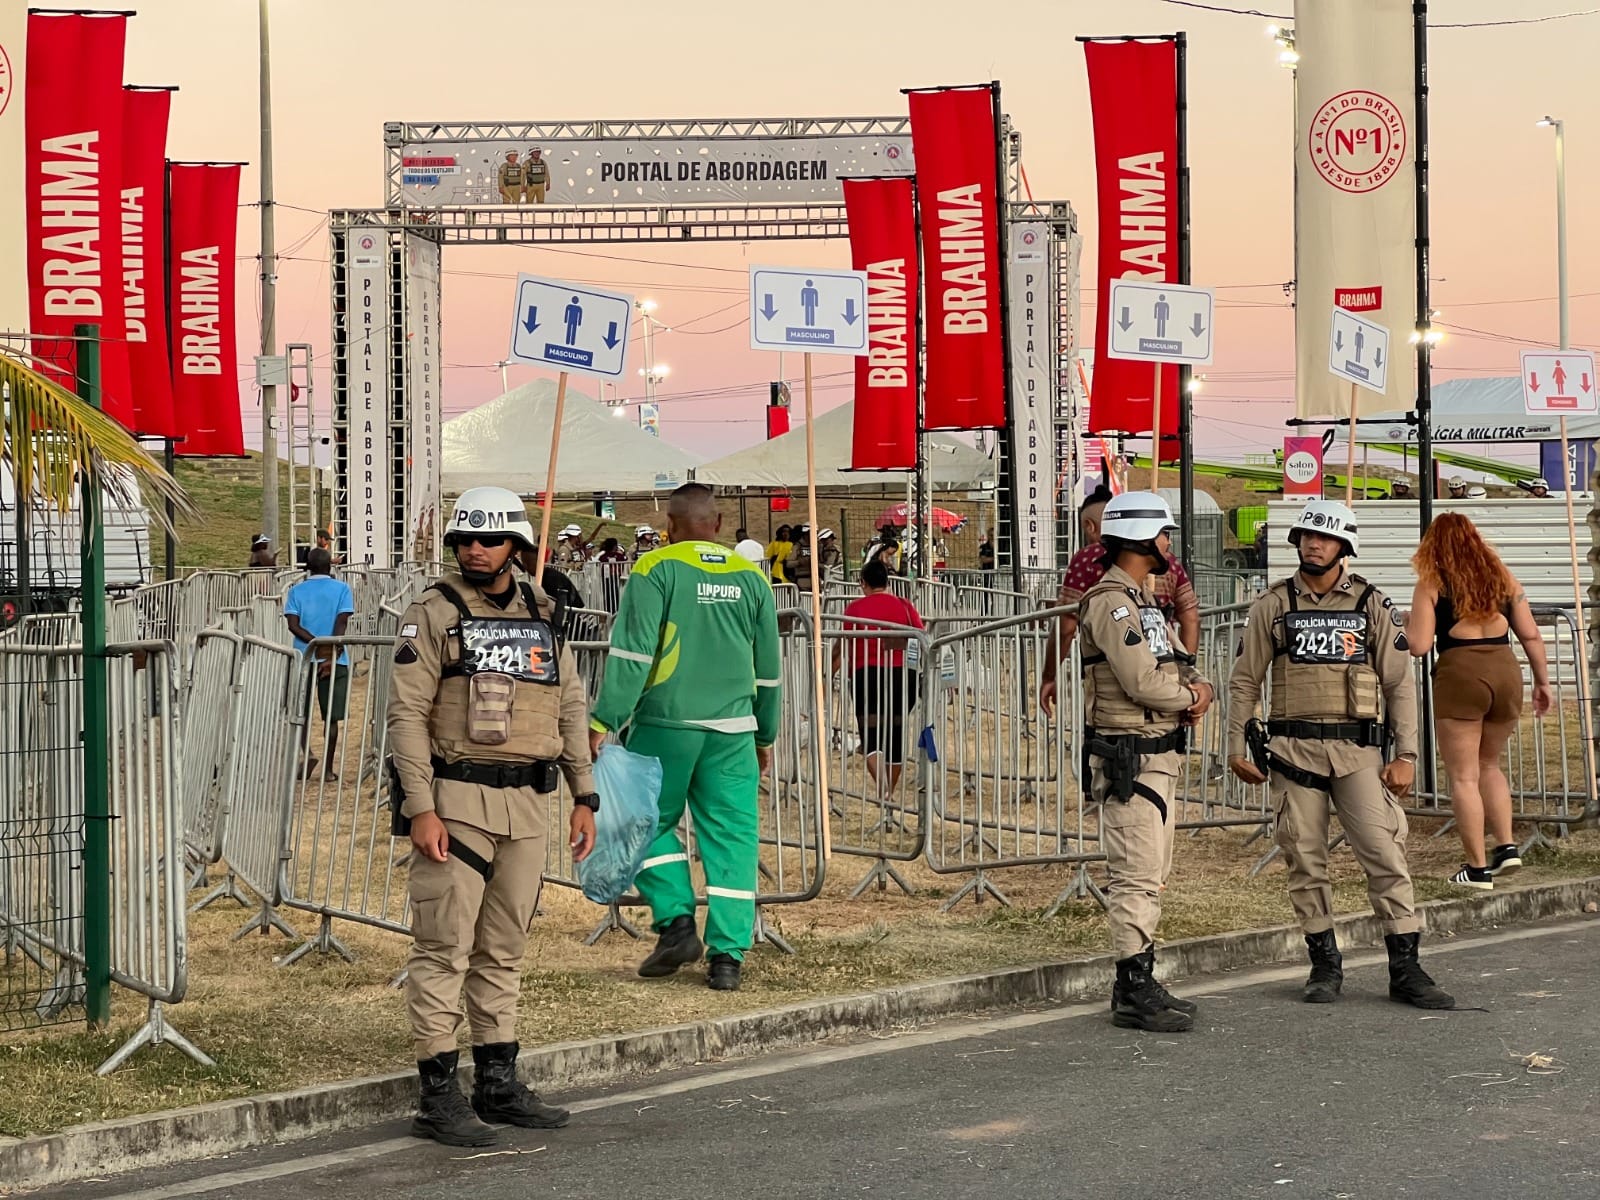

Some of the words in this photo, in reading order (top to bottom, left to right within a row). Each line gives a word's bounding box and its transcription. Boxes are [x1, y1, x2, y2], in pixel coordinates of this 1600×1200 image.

[1340, 97, 1359, 108] DO
[1365, 98, 1400, 136] BRASIL
[601, 161, 672, 182] PORTAL
[677, 161, 700, 181] DE
[705, 160, 827, 181] ABORDAGEM
[1321, 160, 1361, 188] DESDE
[1367, 157, 1396, 184] 1888
[41, 130, 103, 317] BRAHMA
[1119, 151, 1167, 282] AHMA
[936, 184, 988, 335] BRAHMA
[180, 245, 222, 376] BRAHMA
[1339, 291, 1377, 307] BRAHMA
[363, 278, 372, 371] PORTAL
[790, 331, 831, 340] MASCULINO
[866, 258, 908, 388] BRAHMA
[1025, 274, 1035, 369] PORTAL
[548, 347, 589, 362] MASCULINO
[1143, 342, 1179, 351] MASCULINO
[363, 381, 372, 411] DE
[1027, 379, 1035, 408] DE
[1407, 425, 1463, 441] PÍCIA
[1466, 426, 1526, 441] MILITAR
[1288, 460, 1314, 469] salon
[1298, 469, 1314, 477] line
[363, 420, 375, 566] ABORDAGEM
[1027, 419, 1039, 568] ABORDAGEM
[697, 582, 742, 599] LIMPURB
[473, 628, 508, 641] POLÍCIA
[508, 628, 541, 641] MILITAR
[1295, 616, 1326, 628] POLÍCIA
[1327, 617, 1357, 629] MILITAR
[1295, 631, 1337, 656] 2421
[475, 645, 524, 673] 2421
[530, 646, 545, 674] E
